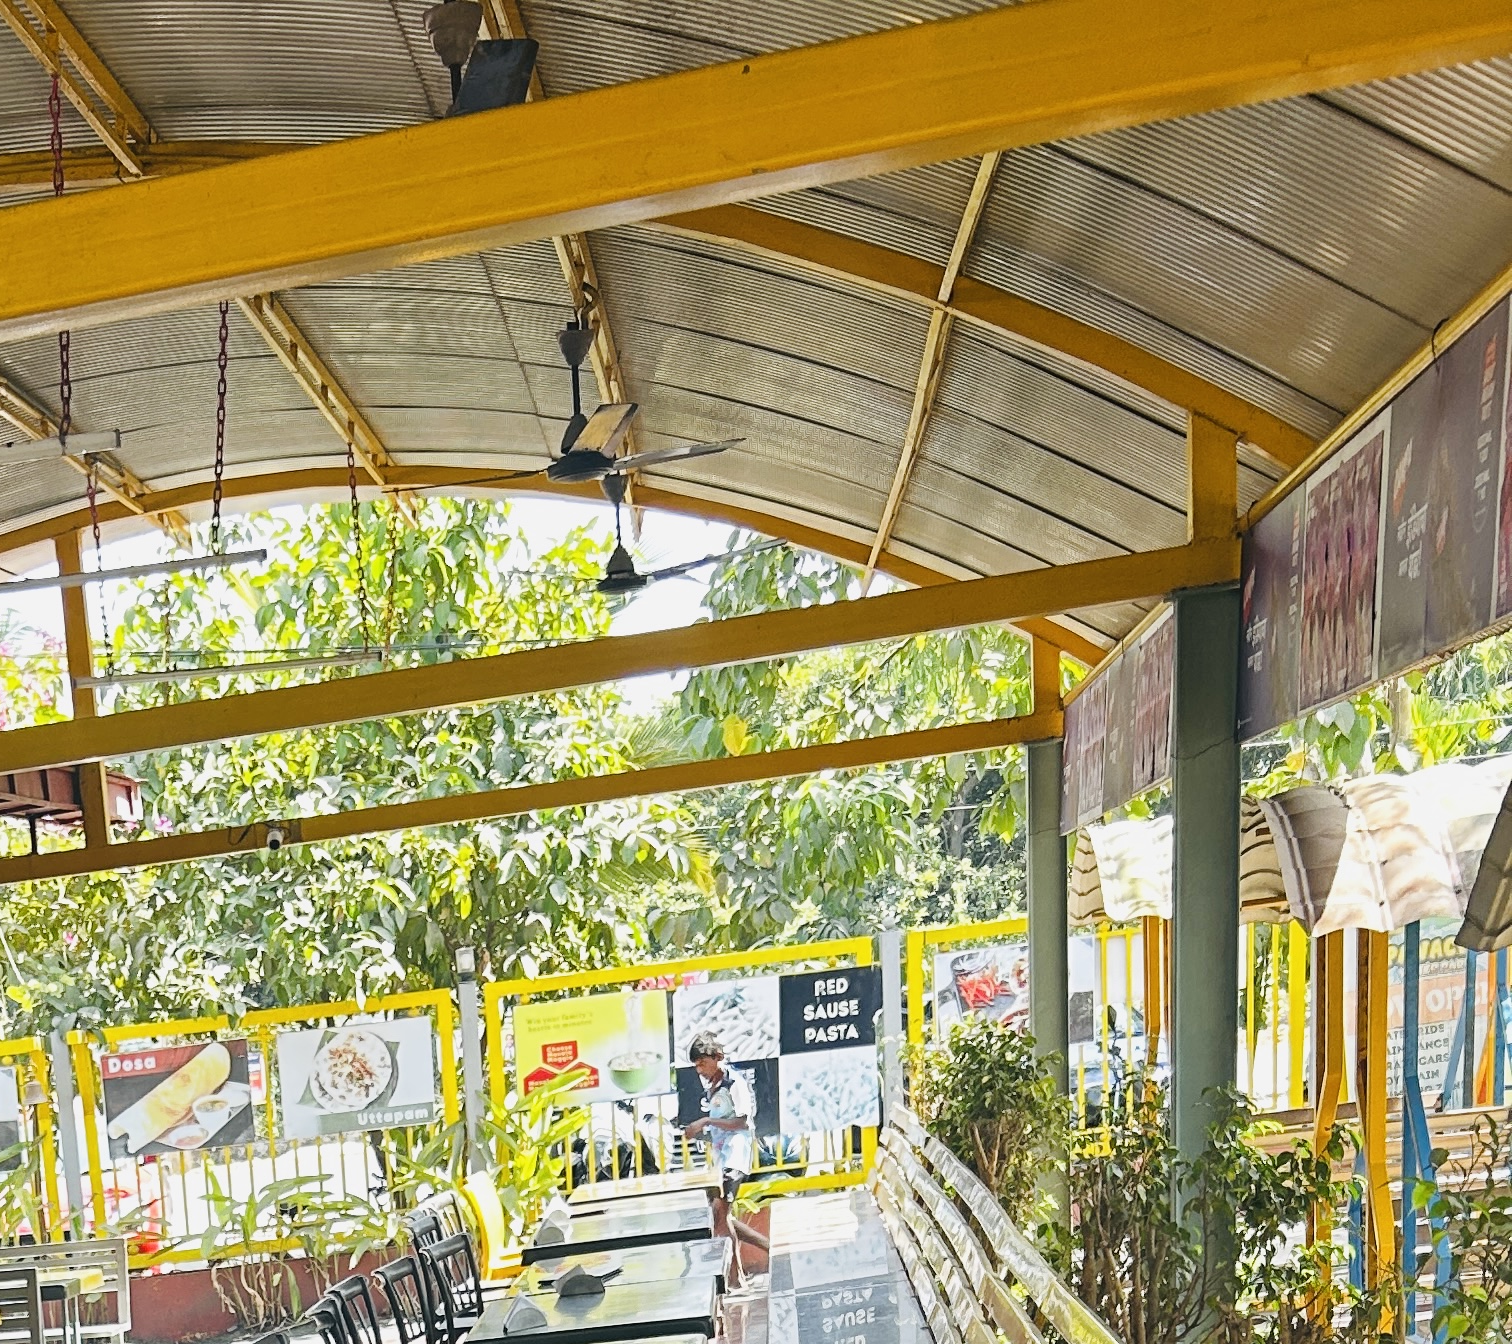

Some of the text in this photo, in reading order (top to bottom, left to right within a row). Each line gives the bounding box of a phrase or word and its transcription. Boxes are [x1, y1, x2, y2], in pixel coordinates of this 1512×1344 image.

[814, 977, 849, 997] RED
[803, 999, 860, 1022] SAUSE
[804, 1023, 860, 1044] PASTA
[107, 1055, 156, 1074] Dosa
[357, 1106, 429, 1127] Uttapam
